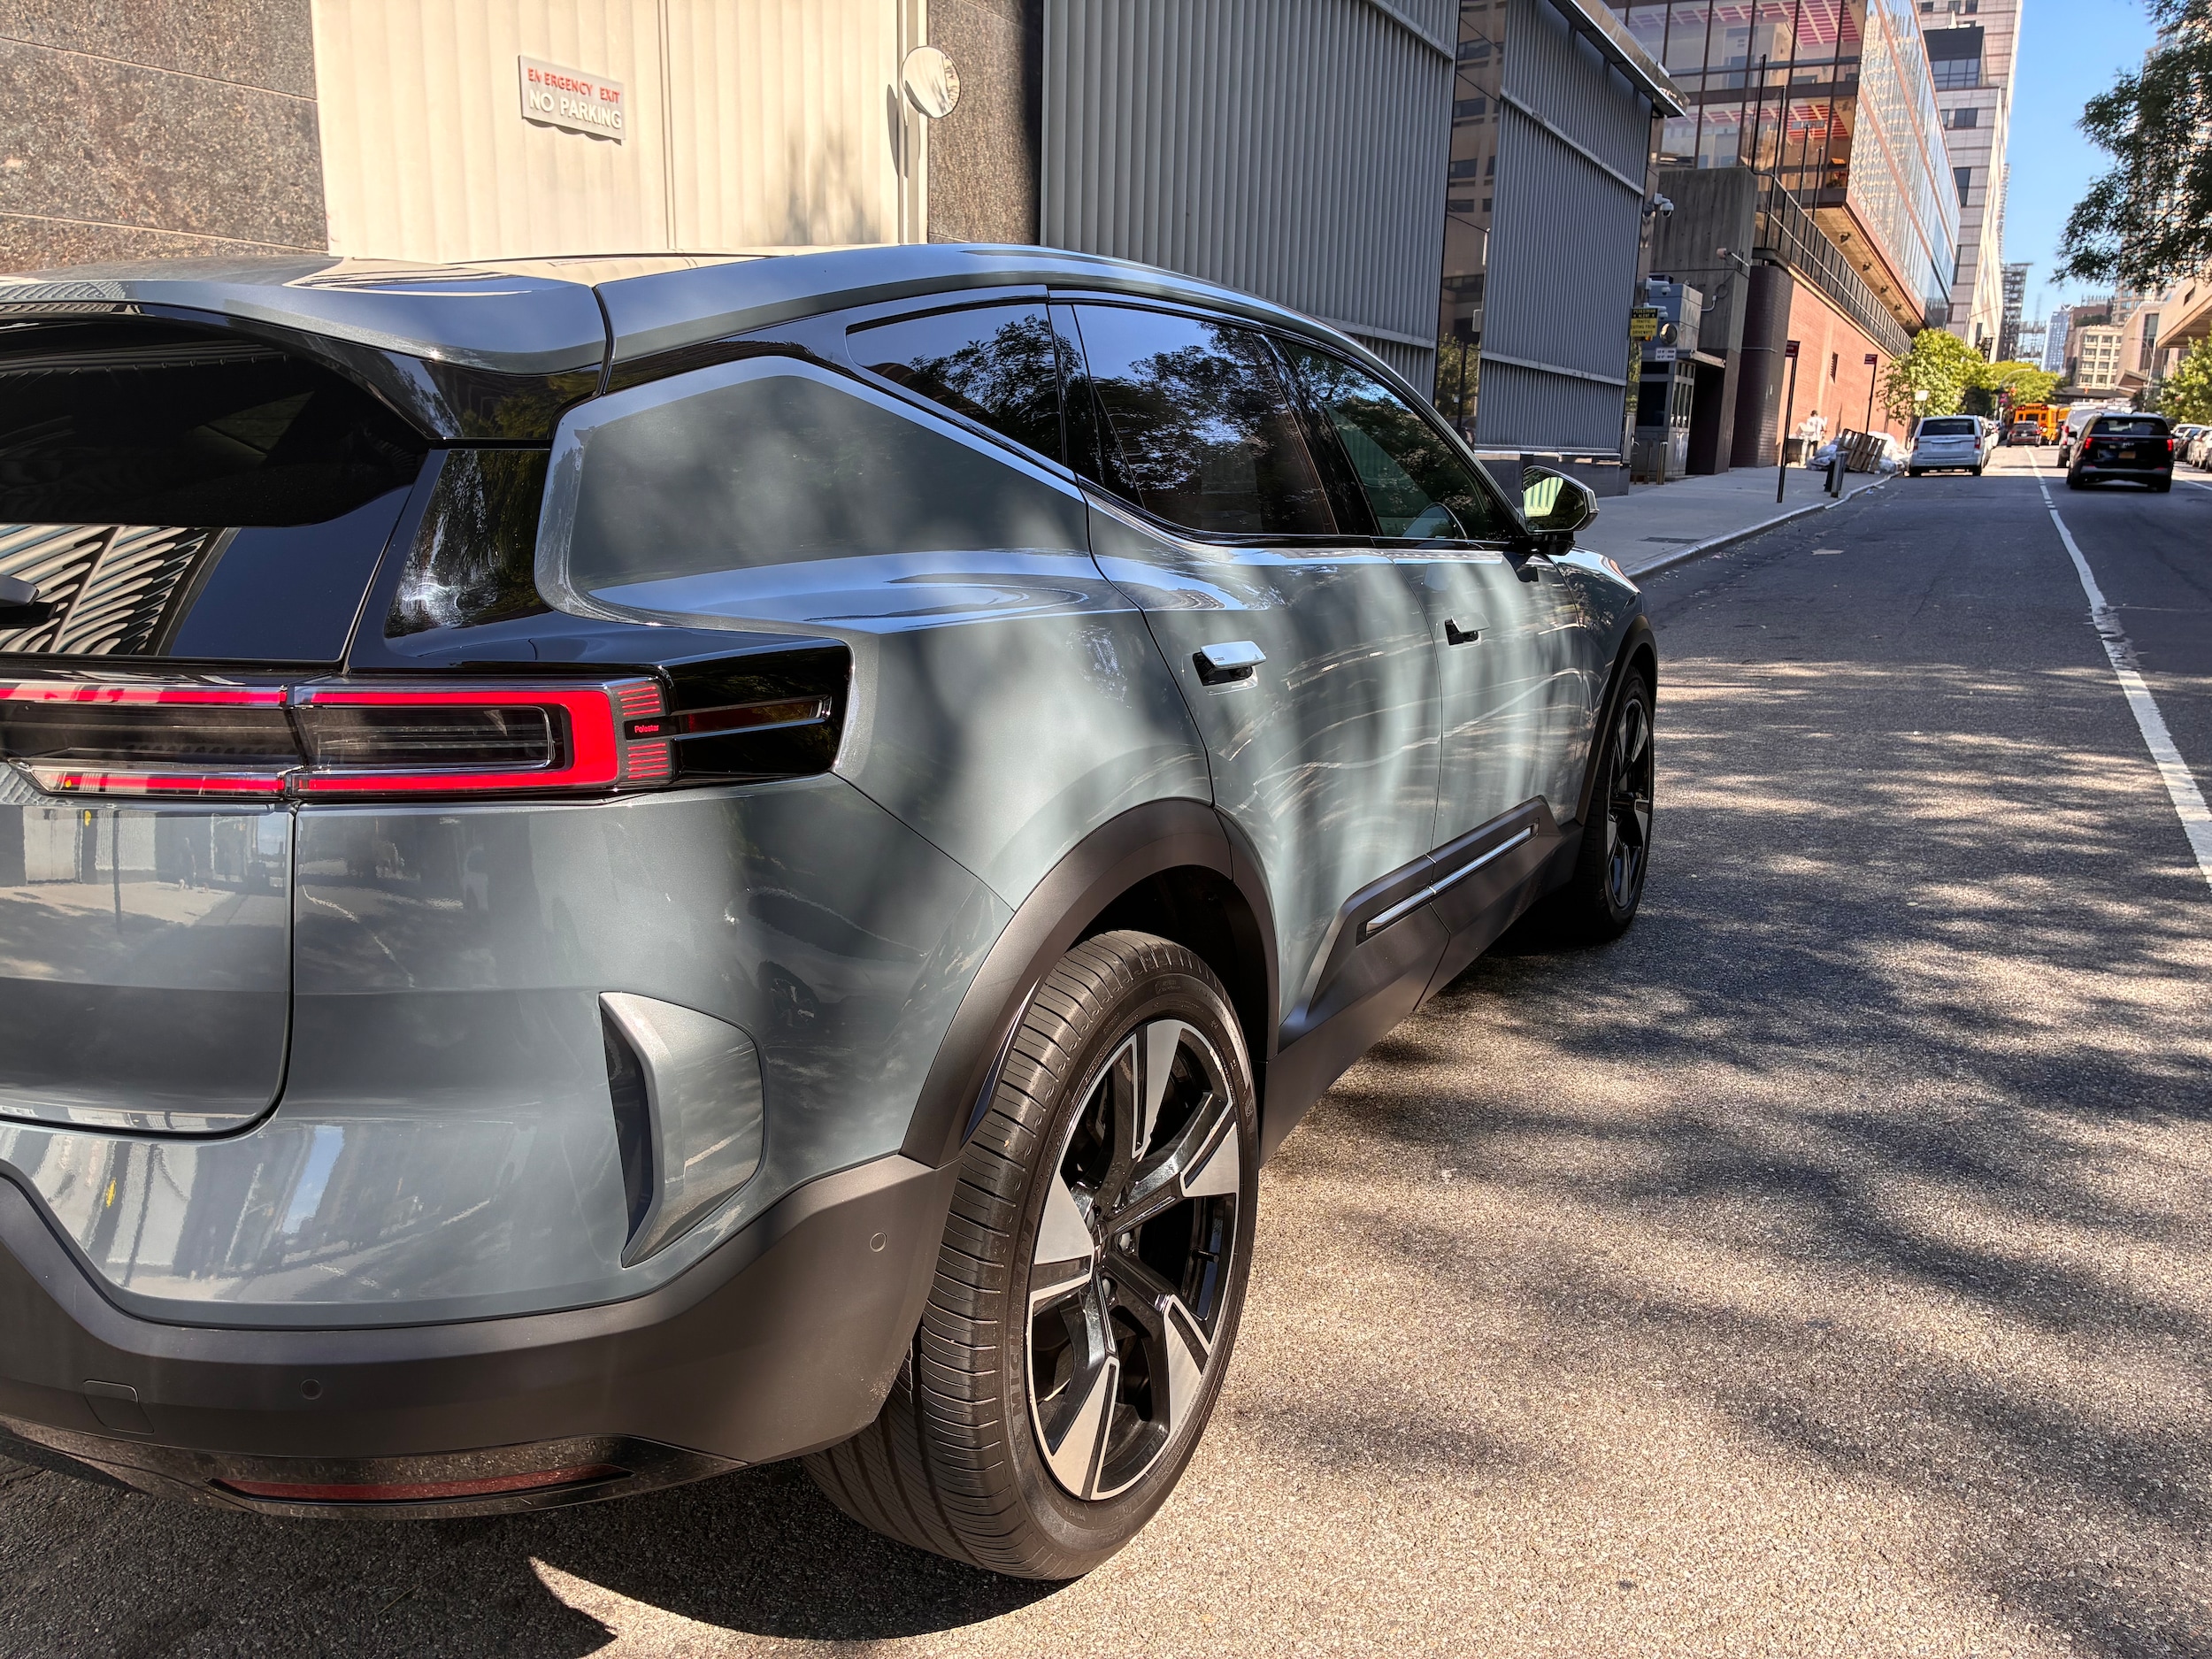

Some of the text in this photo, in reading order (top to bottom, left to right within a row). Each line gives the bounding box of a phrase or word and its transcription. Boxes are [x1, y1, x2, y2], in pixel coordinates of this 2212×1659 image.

[600, 87, 620, 104] EXIT
[529, 88, 622, 129] NO PARKING
[634, 725, 659, 733] Polestar
